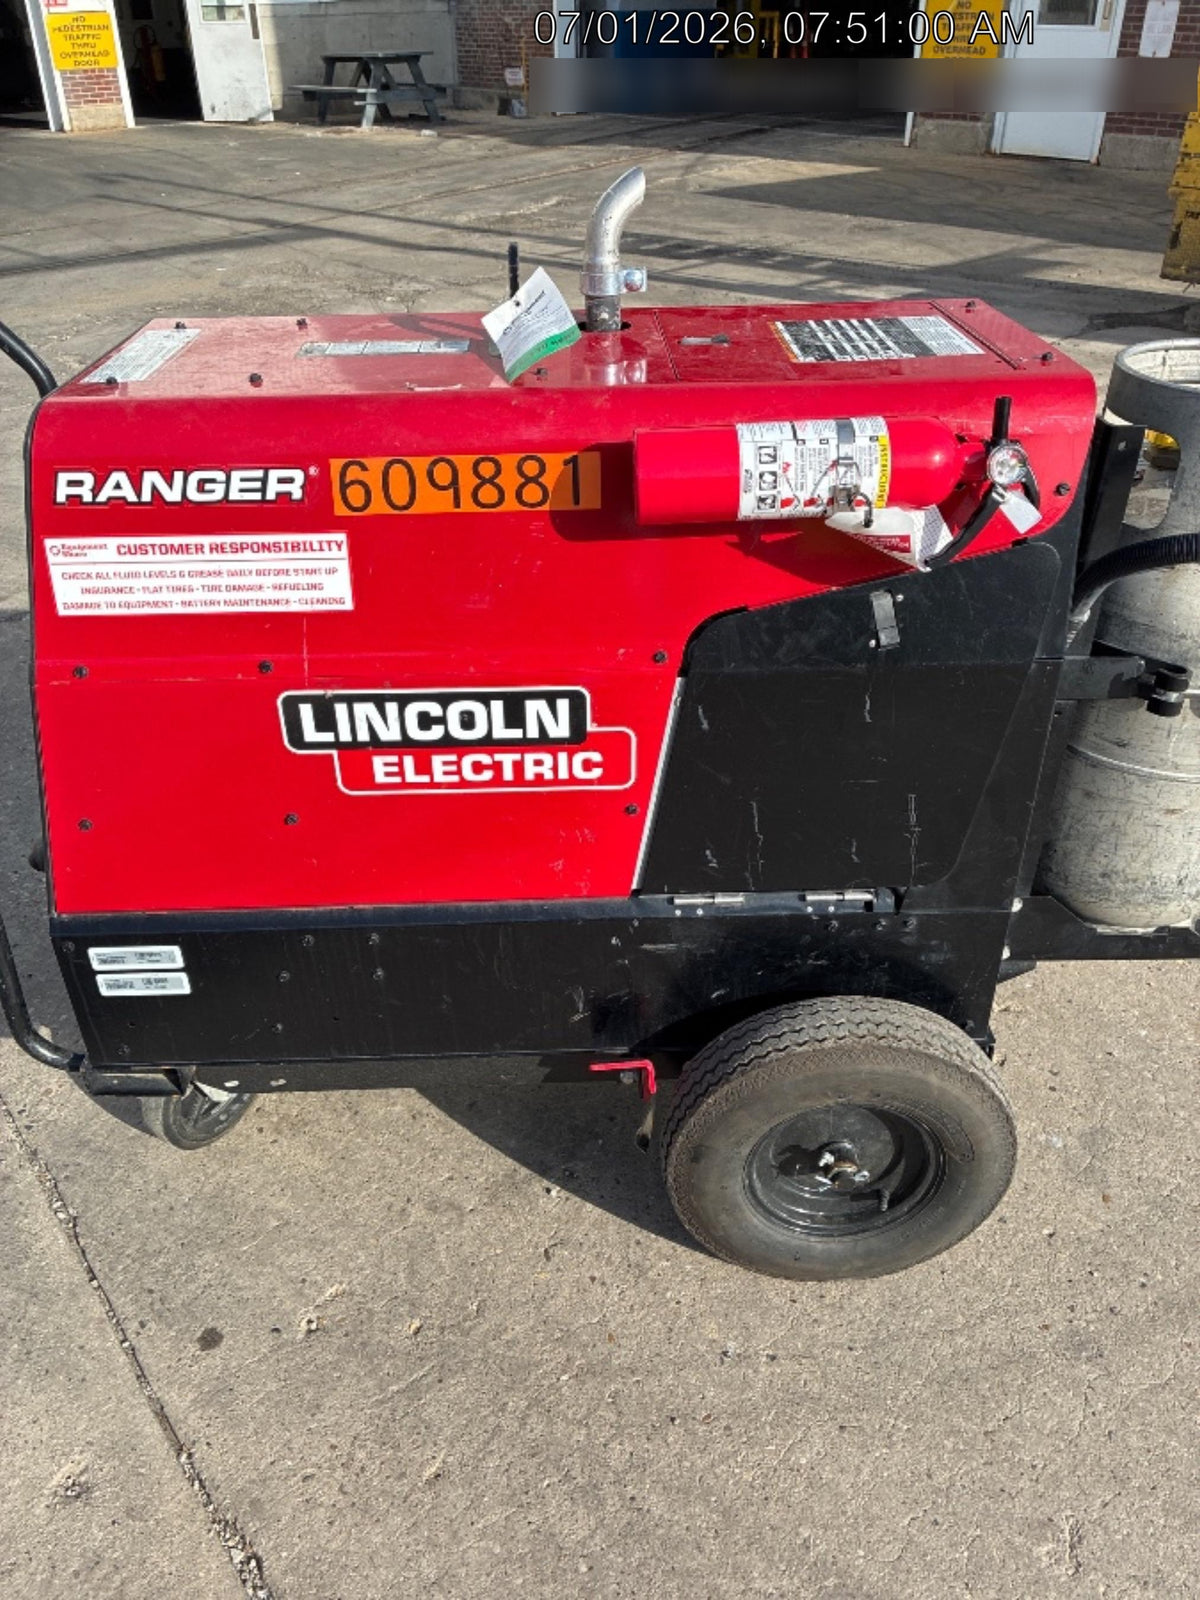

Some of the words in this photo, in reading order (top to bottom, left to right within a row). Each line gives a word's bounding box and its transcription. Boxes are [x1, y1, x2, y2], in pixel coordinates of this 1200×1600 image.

[63, 33, 101, 41] TRAFFIC
[60, 50, 110, 59] OVERHEAD
[933, 45, 986, 55] OVERHEAD
[55, 469, 306, 504] RANGER
[338, 454, 582, 513] 609881
[116, 543, 205, 556] CUSTOMER
[208, 540, 344, 554] RESPONSIBILITY
[61, 571, 94, 580] CHECK
[95, 571, 112, 580] ALL
[113, 570, 141, 580] FLUID
[143, 569, 177, 579] LEVELS
[187, 569, 225, 578] GREASE
[226, 568, 254, 577] DAILY
[255, 568, 292, 577] BEFORE
[293, 567, 323, 576] START
[324, 566, 338, 576] UP
[80, 585, 135, 595] INSURANCE
[141, 585, 163, 594] FLAT
[200, 584, 224, 593] TIRE
[225, 583, 265, 592] DAMAGE
[271, 582, 324, 592] REFUELING
[104, 600, 117, 609] TO
[118, 600, 174, 609] EQUIPMENT
[180, 599, 221, 608] BATTERY
[223, 598, 292, 607] MAINTENANCE
[298, 596, 346, 605] CLEANING
[299, 698, 571, 743] LINCOLN
[372, 751, 604, 784] ELECTRIC
